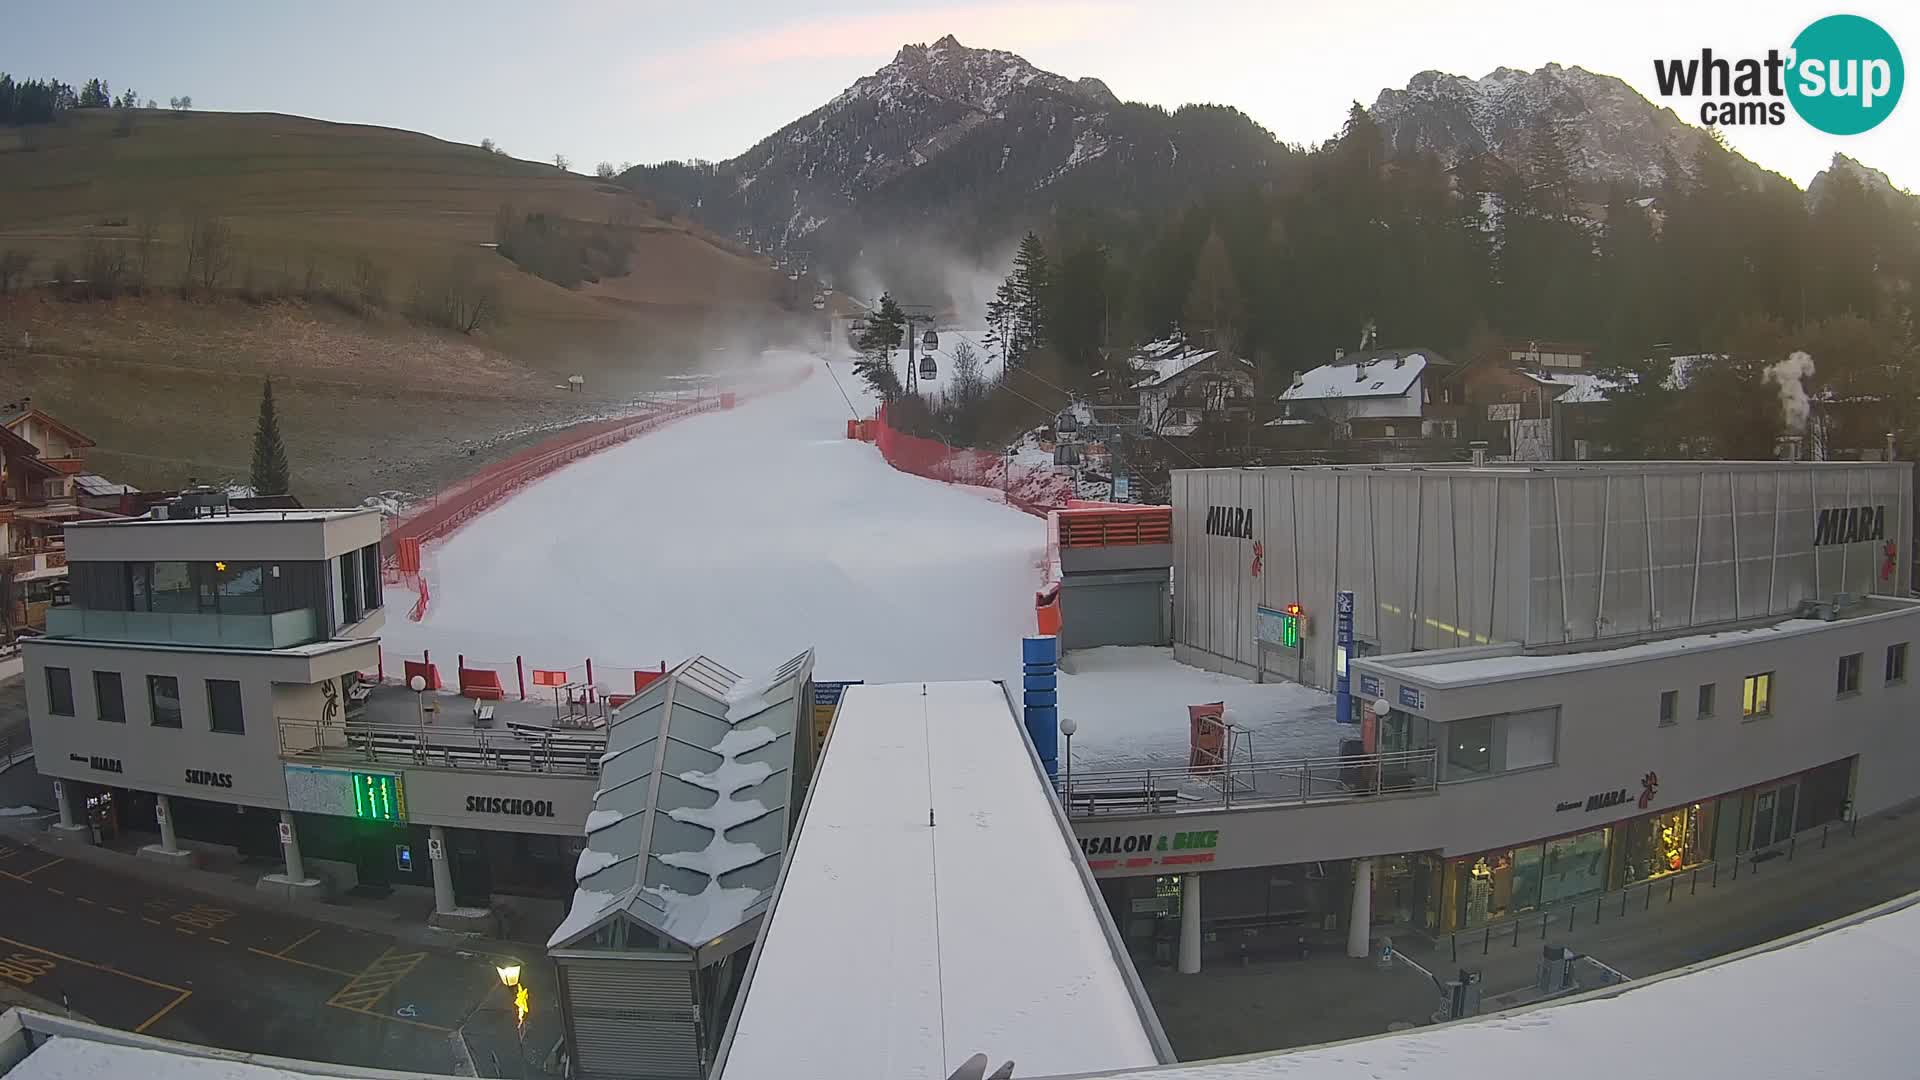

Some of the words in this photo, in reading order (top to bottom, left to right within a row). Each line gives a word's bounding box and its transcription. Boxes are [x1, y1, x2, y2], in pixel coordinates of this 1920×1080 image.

[1206, 505, 1253, 540] MIARA
[1813, 505, 1884, 546] MIARA
[91, 755, 123, 774] MIARA
[185, 768, 232, 789] SKIPASS
[465, 795, 554, 818] SKISCHOOL
[1585, 788, 1627, 812] MIARA
[1156, 835, 1168, 851] &
[1173, 830, 1219, 850] BIKE
